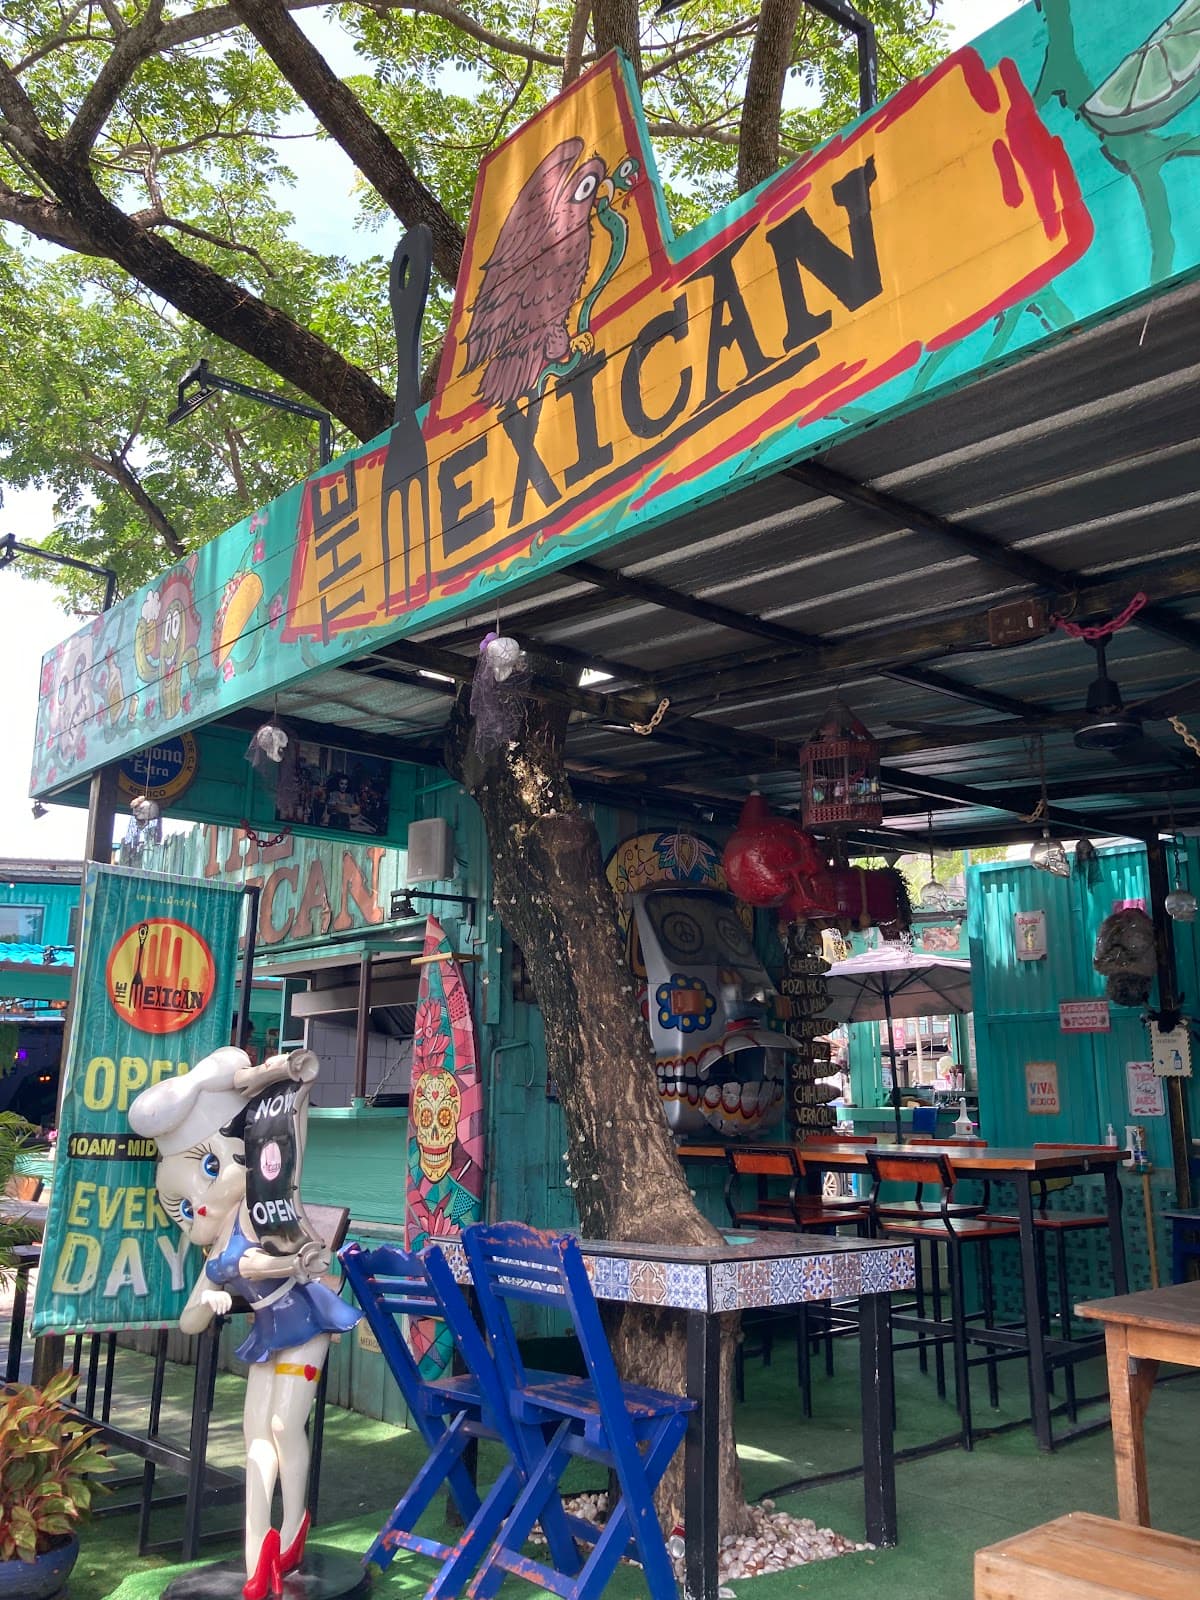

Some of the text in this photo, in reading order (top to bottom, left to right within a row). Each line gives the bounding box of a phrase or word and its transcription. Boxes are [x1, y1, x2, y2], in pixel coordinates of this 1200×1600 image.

[314, 464, 364, 643] THE
[134, 760, 169, 777] Extra
[114, 981, 127, 1005] THE
[1061, 1003, 1108, 1014] MEXICAN
[1071, 1016, 1098, 1026] FOOD
[1030, 1082, 1054, 1094] VIVA
[1030, 1097, 1056, 1106] MEXICO
[71, 1138, 116, 1156] 10AM
[253, 1200, 297, 1225] OPEN
[52, 1232, 191, 1298] DAY
